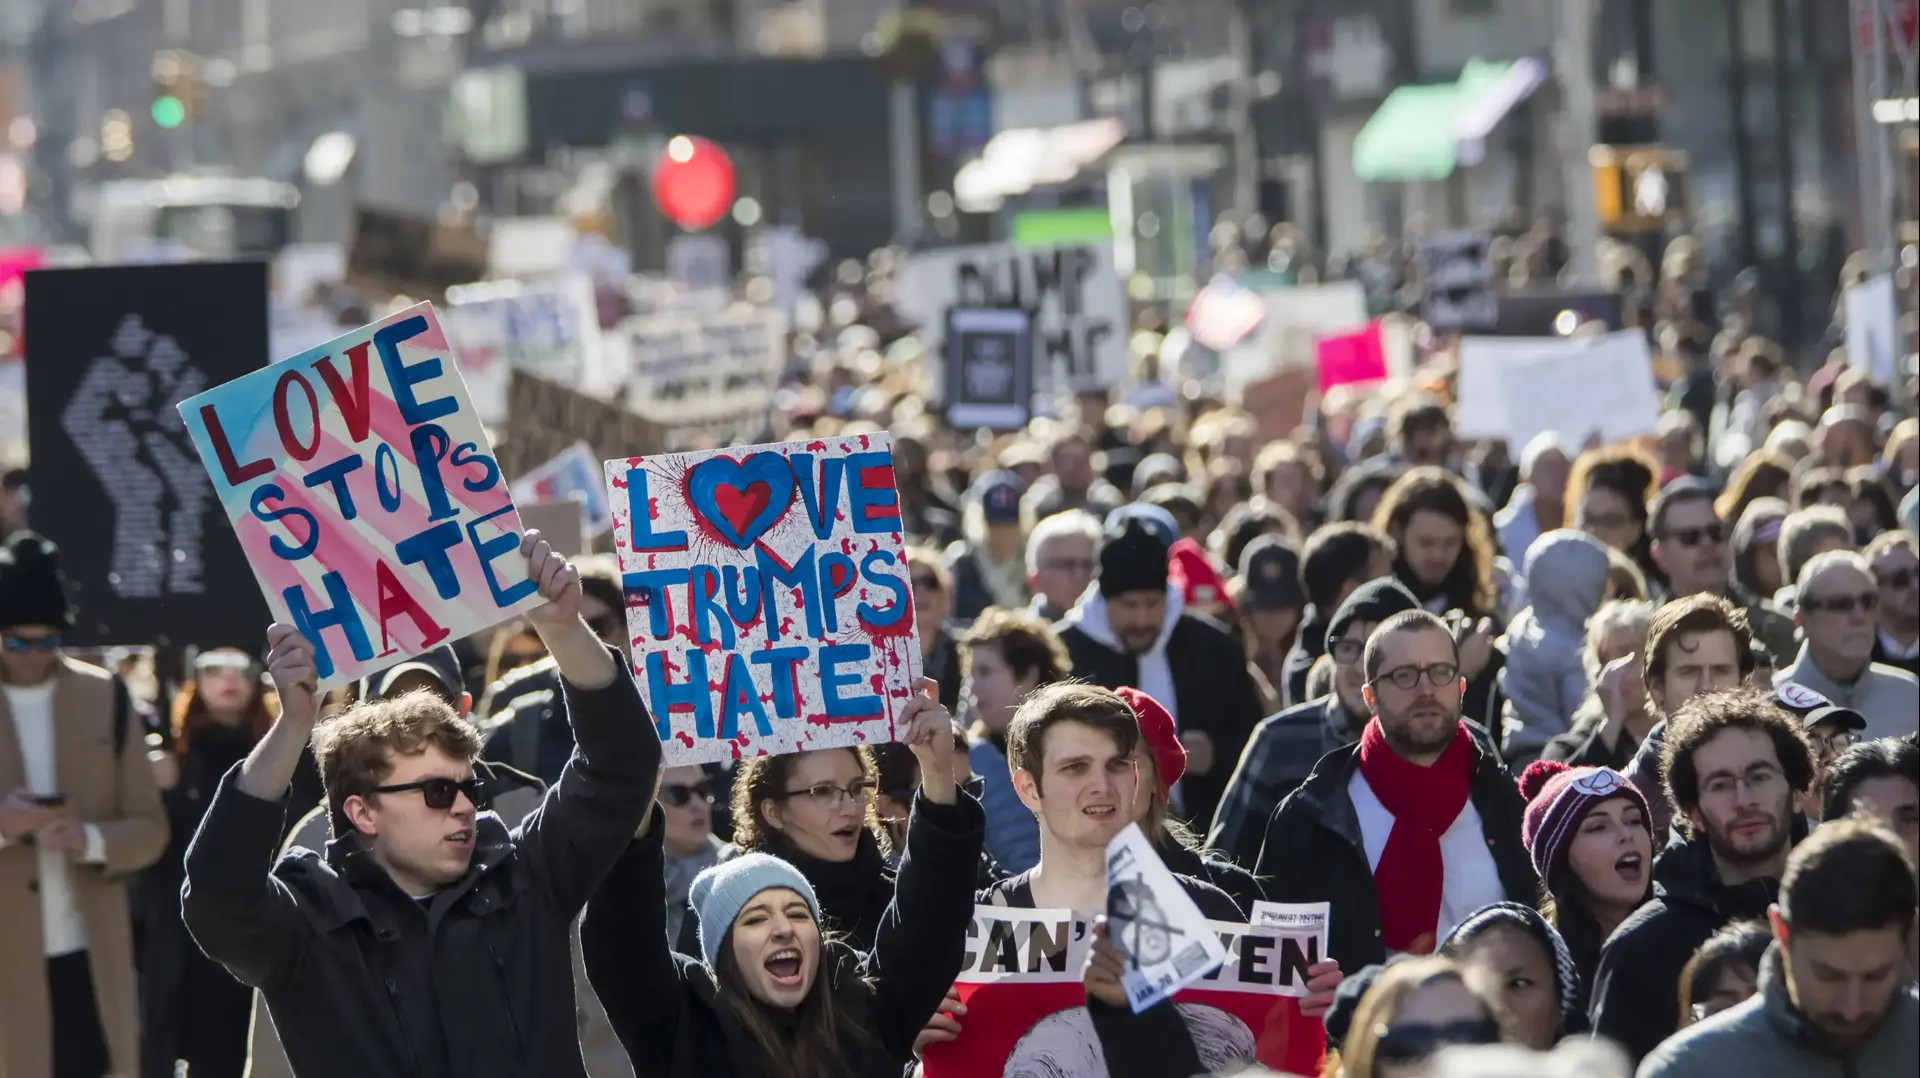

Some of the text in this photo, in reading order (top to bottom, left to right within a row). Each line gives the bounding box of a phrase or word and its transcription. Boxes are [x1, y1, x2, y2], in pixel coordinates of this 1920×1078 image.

[200, 315, 460, 487] LOVE
[249, 423, 500, 562] STOPS
[282, 504, 538, 679] HATE
[622, 542, 911, 650] TRUMPS
[645, 644, 885, 740] HATE
[960, 917, 1087, 973] CAN'
